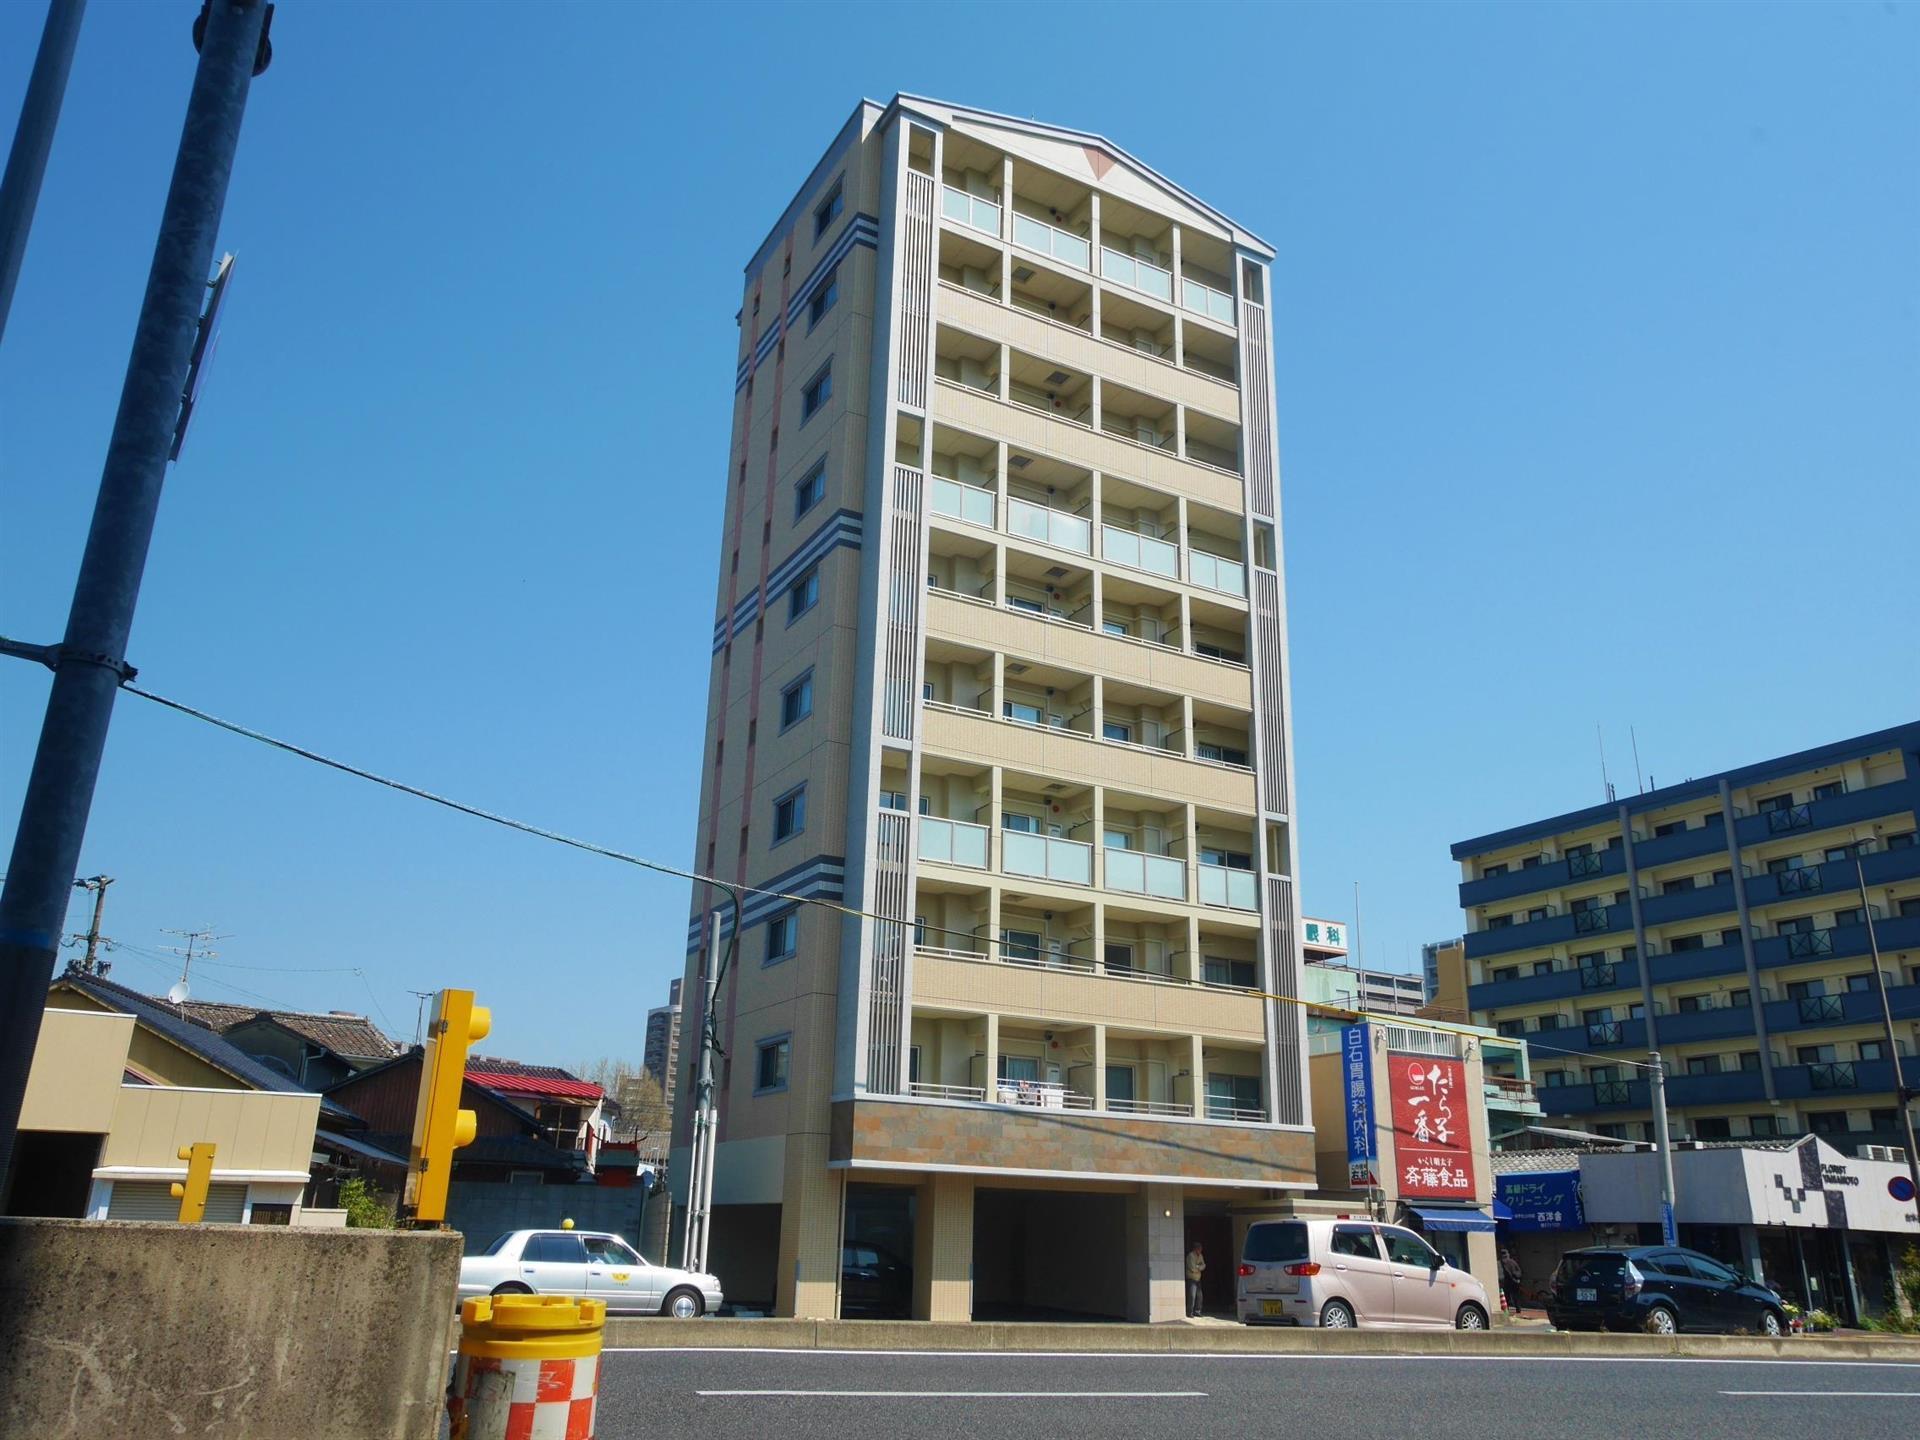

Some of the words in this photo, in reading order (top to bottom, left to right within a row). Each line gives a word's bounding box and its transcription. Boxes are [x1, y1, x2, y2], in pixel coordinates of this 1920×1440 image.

[1305, 923, 1340, 946] 眼科
[1348, 1027, 1369, 1155] 白石胃腸科内科
[1407, 1095, 1436, 1142] 一番
[1820, 1163, 1847, 1175] FLORIST
[1822, 1173, 1859, 1187] YAMAMOTO
[1506, 1193, 1565, 1206] クリーニング
